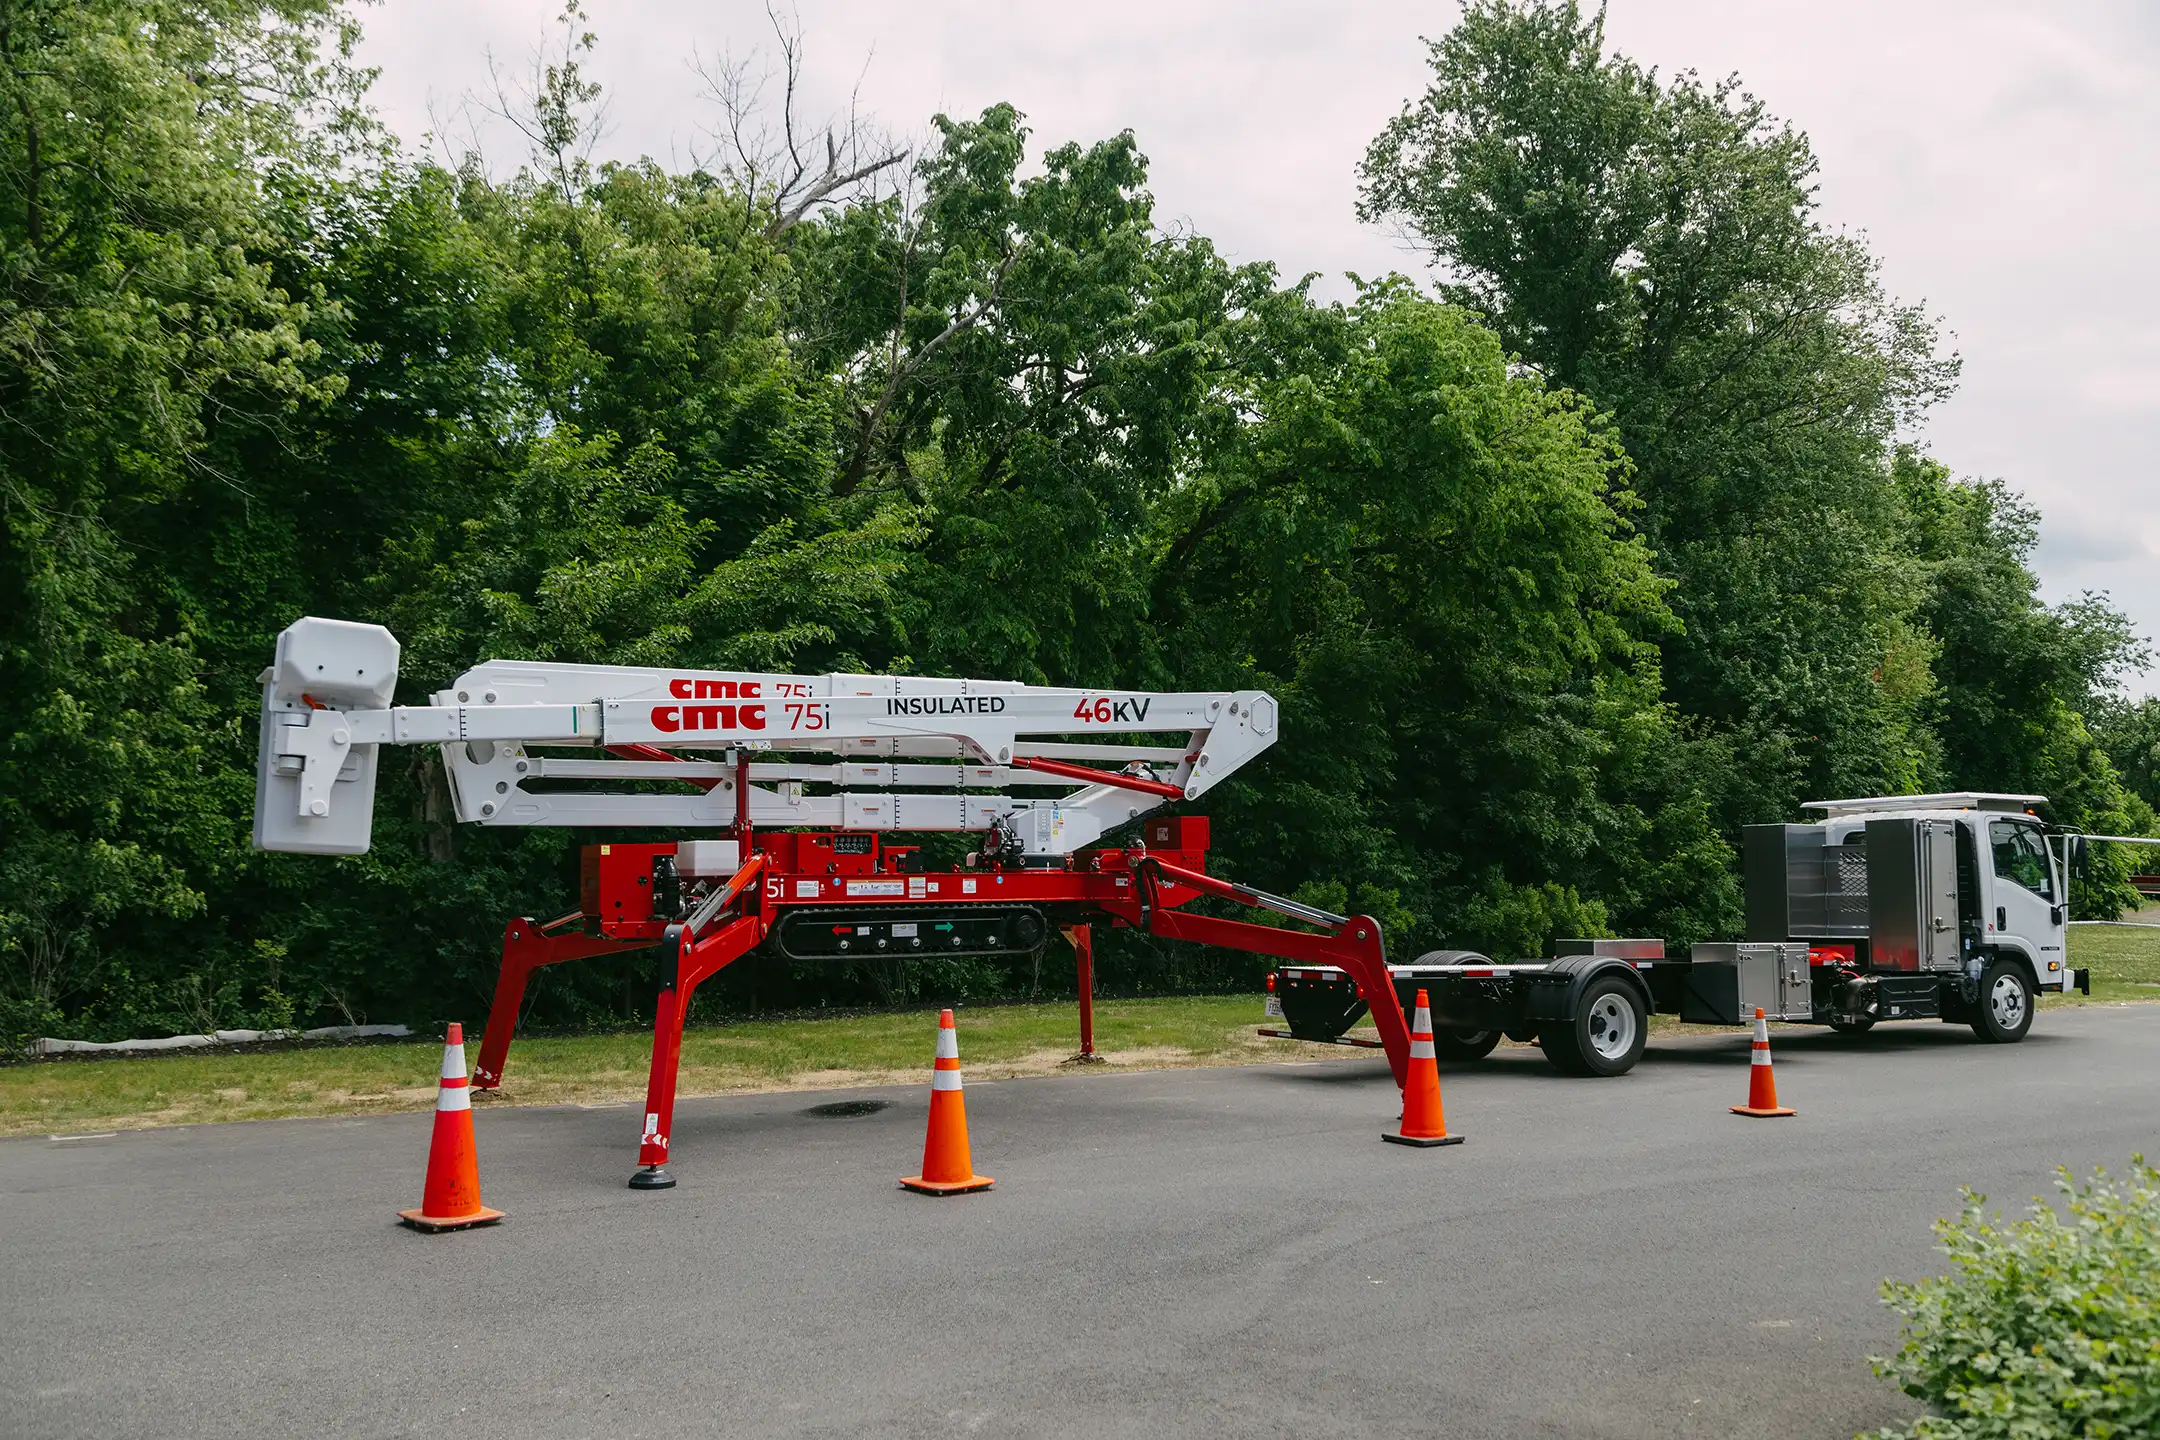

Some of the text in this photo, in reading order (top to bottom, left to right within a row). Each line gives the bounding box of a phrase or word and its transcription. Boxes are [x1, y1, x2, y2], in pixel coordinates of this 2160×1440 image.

[669, 679, 813, 699] cmc 75i
[887, 696, 1005, 715] INSULATED
[651, 703, 830, 733] cmc 75i
